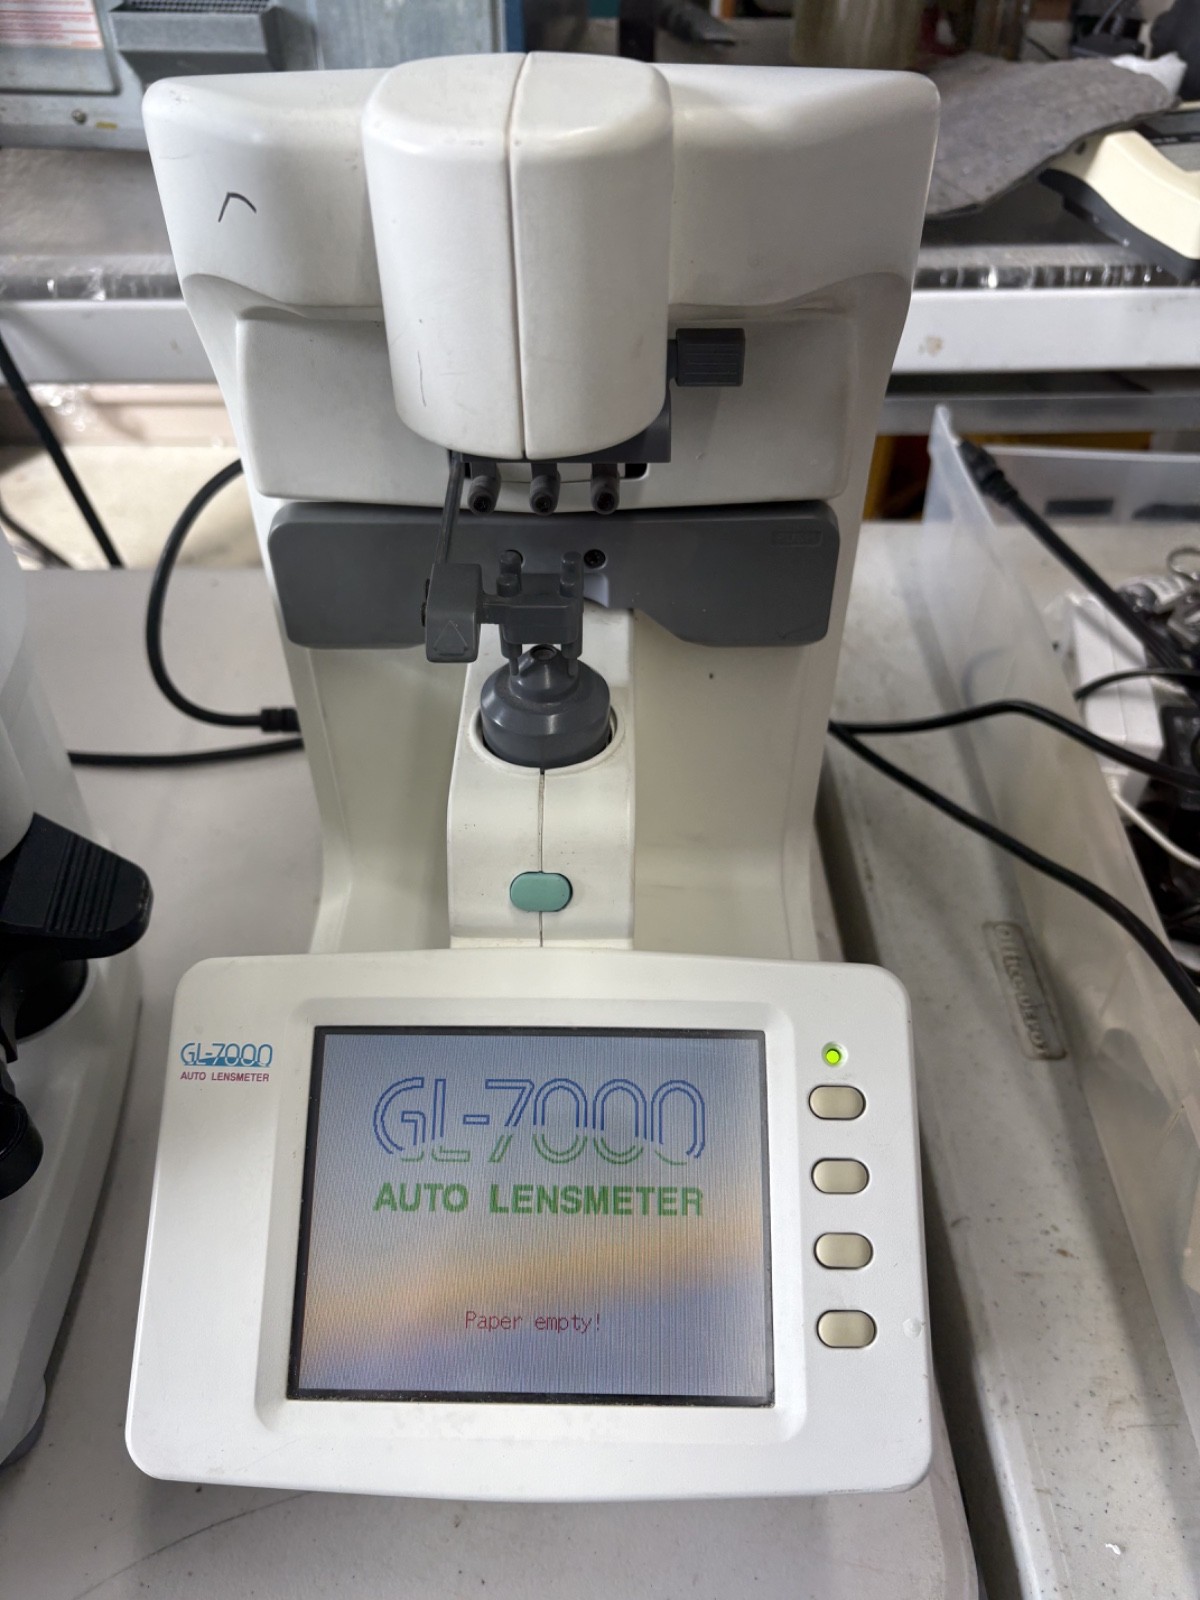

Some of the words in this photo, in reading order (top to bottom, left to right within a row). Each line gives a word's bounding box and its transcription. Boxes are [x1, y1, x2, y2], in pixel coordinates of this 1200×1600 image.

[180, 1042, 273, 1068] GL-7000
[180, 1071, 207, 1081] AUTO
[211, 1071, 270, 1082] LENSMETER
[373, 1077, 706, 1165] GL-7000
[372, 1182, 469, 1213] AUTO
[489, 1183, 704, 1217] LENSMETER
[465, 1310, 523, 1332] Paper
[534, 1313, 601, 1334] empty!
